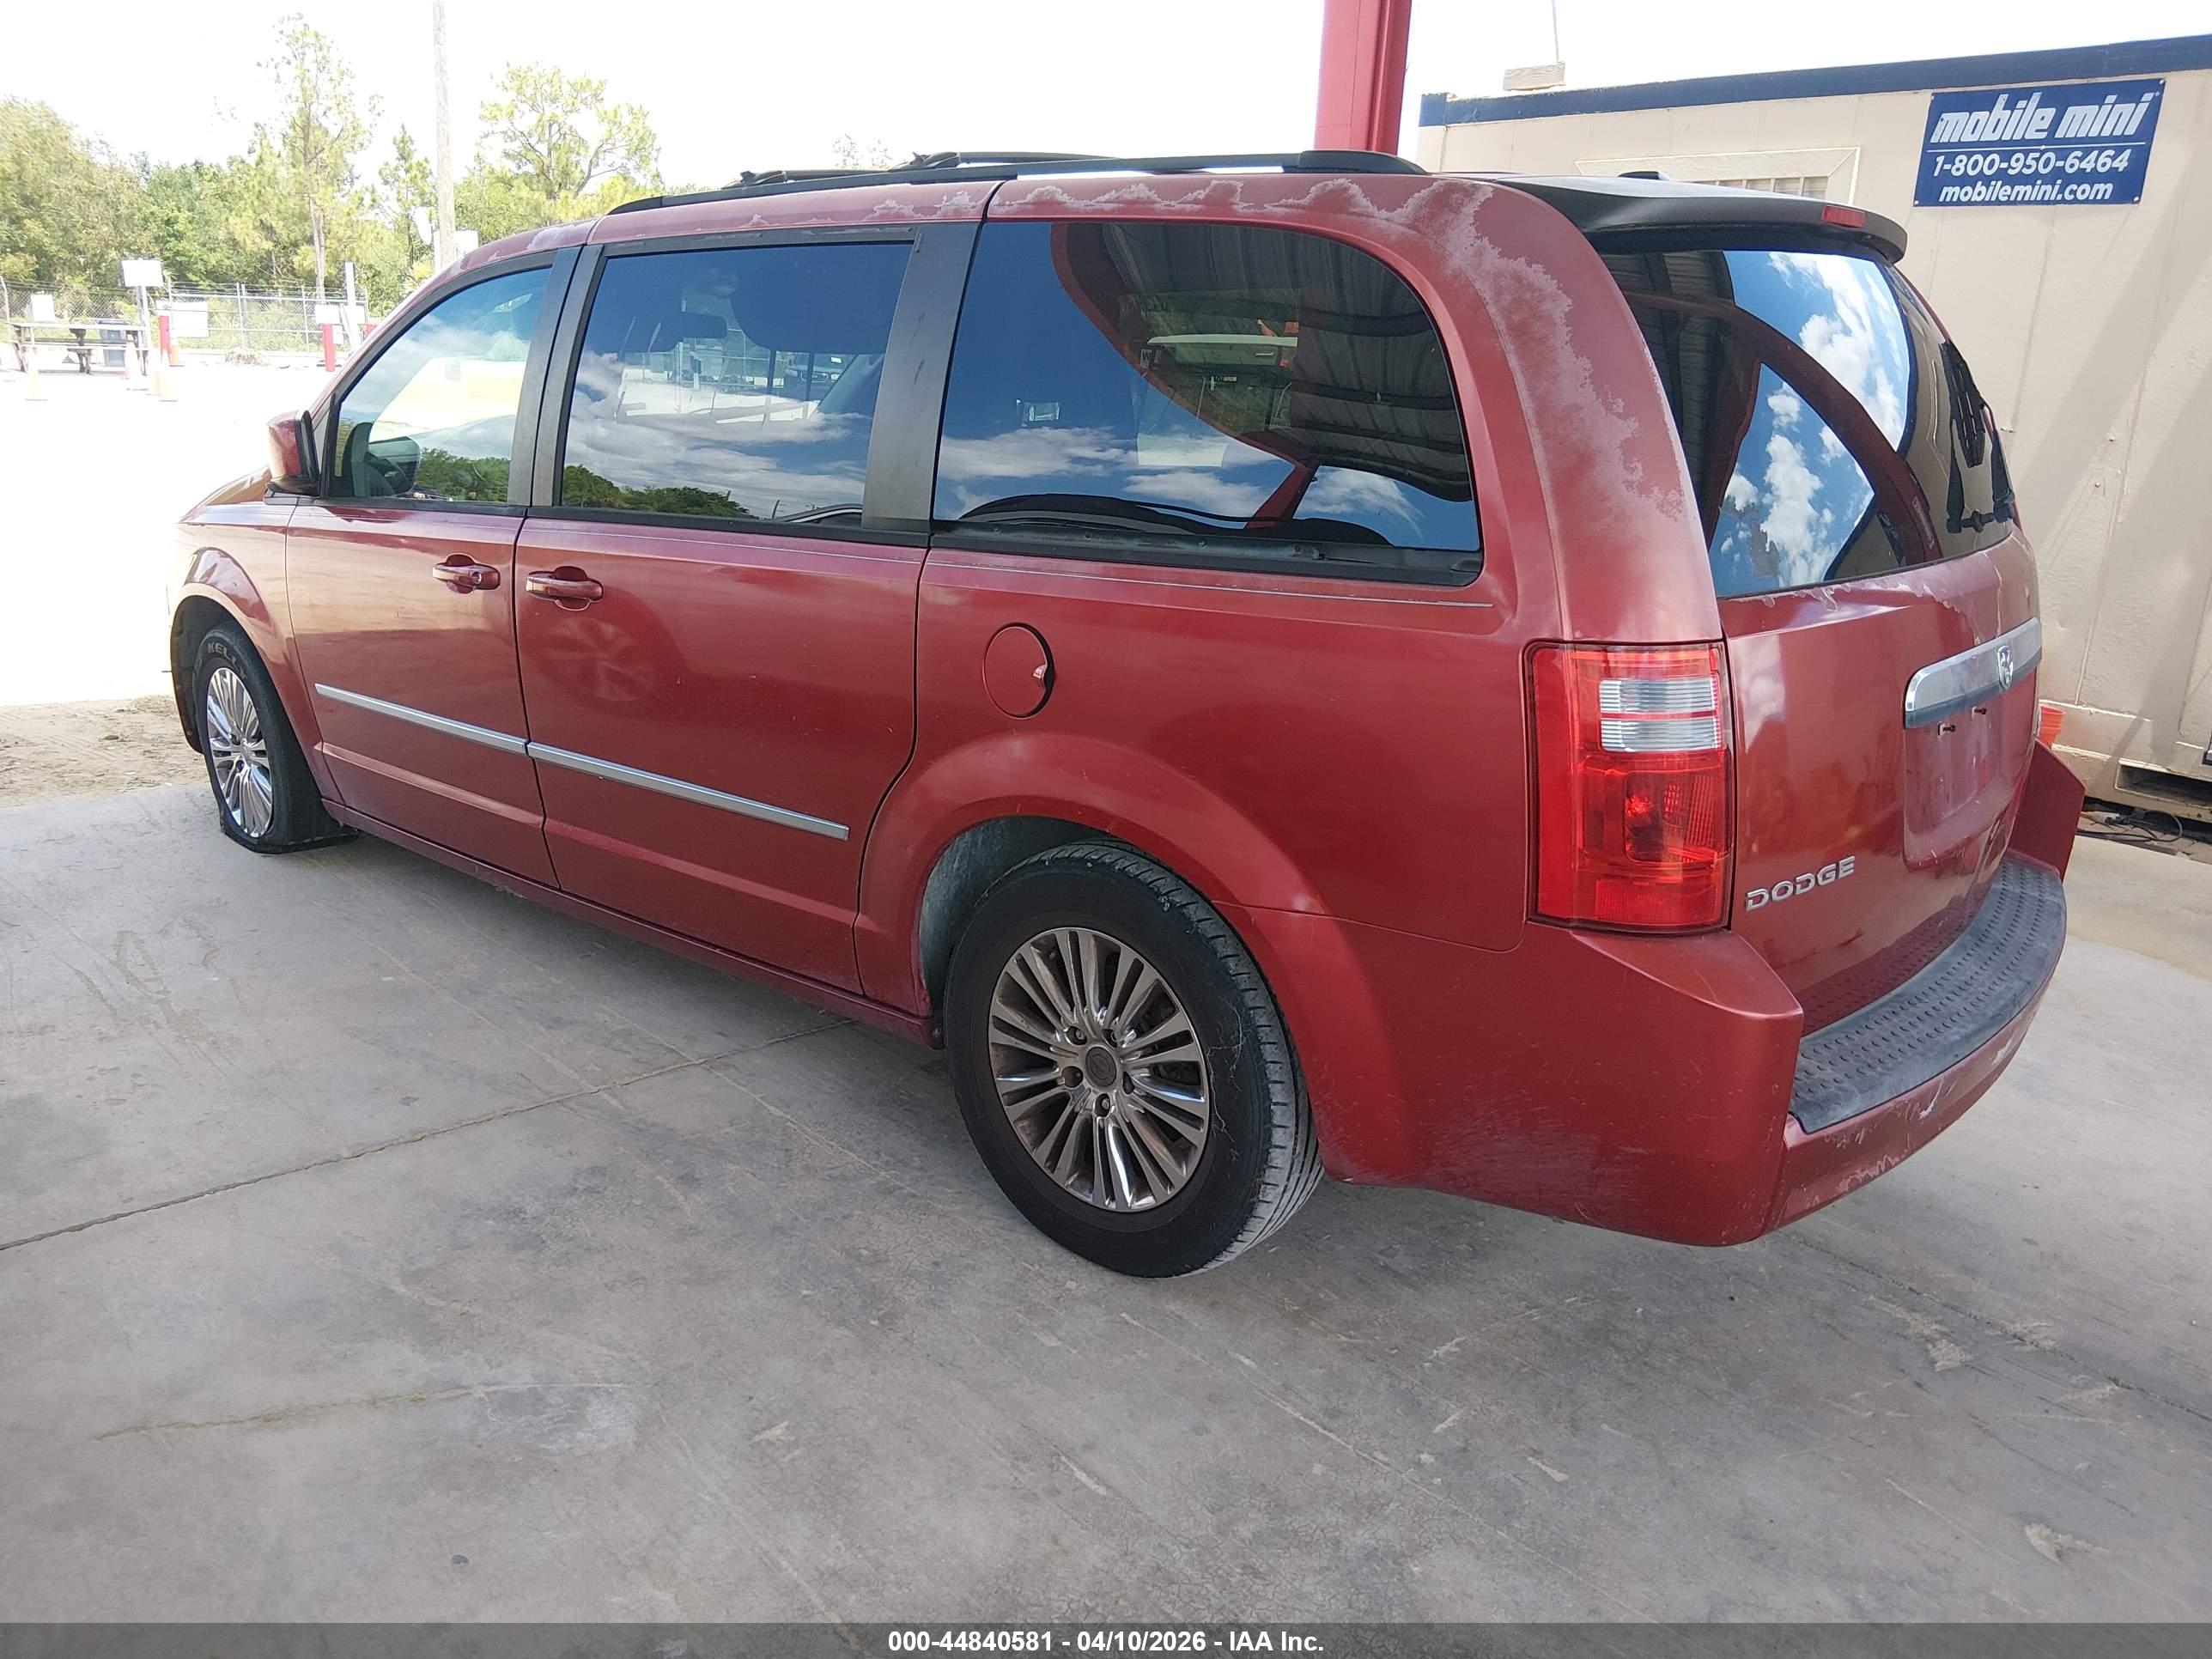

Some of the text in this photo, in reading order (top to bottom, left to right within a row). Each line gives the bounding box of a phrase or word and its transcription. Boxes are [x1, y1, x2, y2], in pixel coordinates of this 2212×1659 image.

[1930, 92, 2155, 143] mobile mini
[1933, 149, 2131, 177] 1-800-950-6464
[1939, 179, 2113, 203] mobilemini.com
[1746, 855, 1856, 912] DODGE
